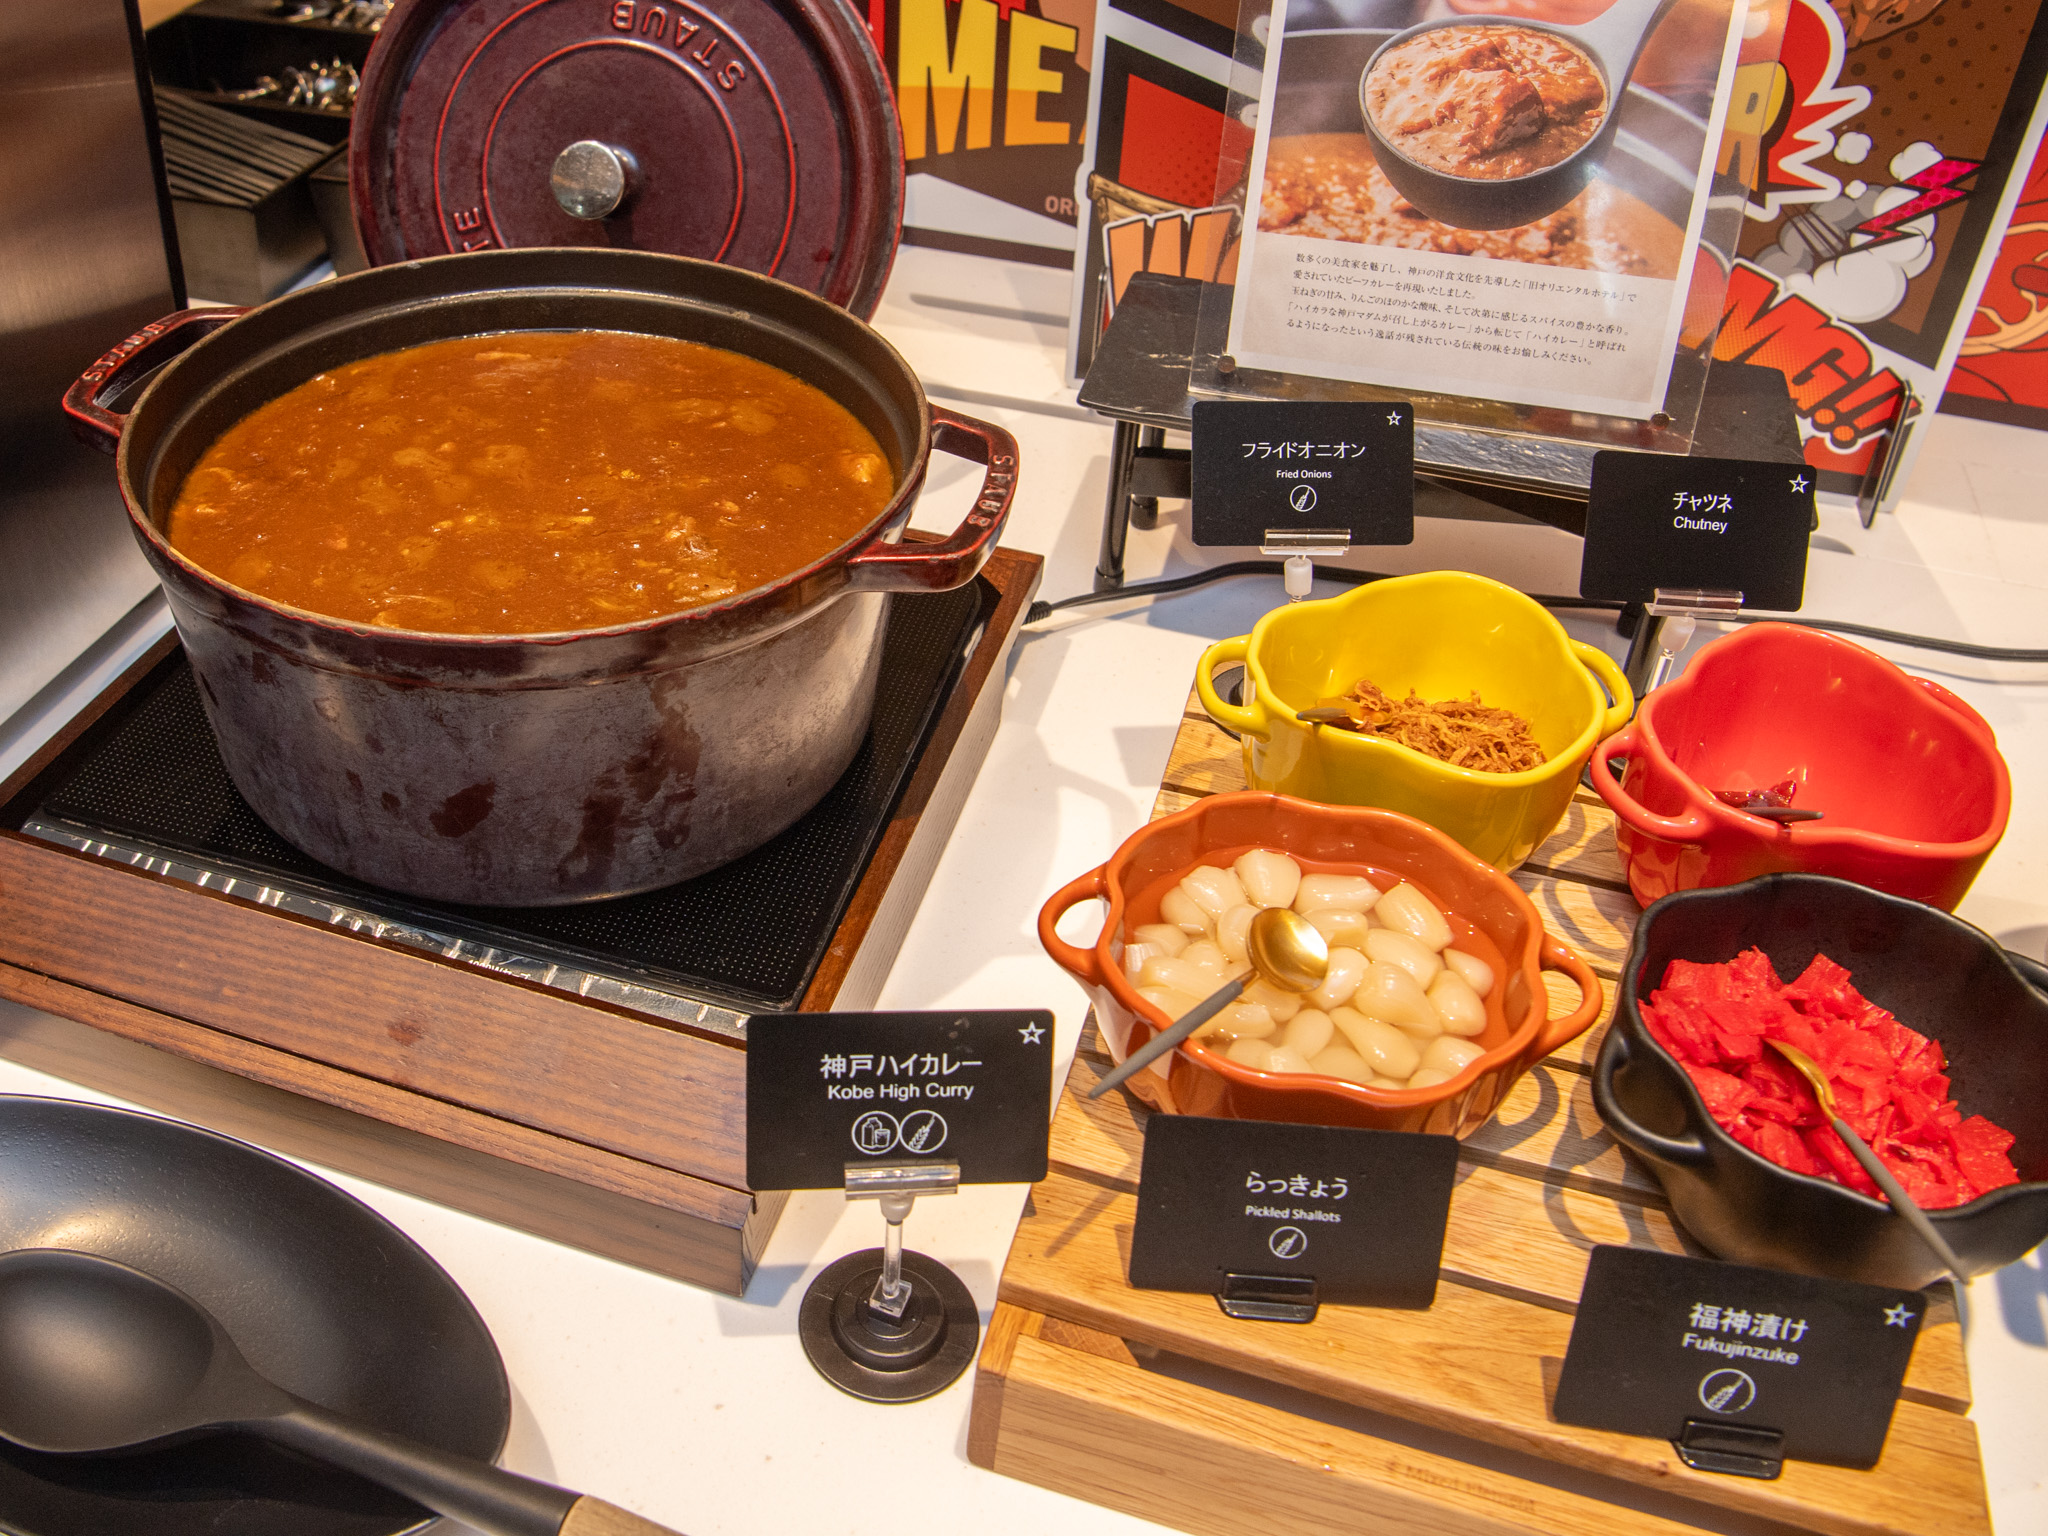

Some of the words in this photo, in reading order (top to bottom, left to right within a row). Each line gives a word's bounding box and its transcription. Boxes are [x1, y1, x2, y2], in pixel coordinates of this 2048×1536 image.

[613, 1, 746, 91] STAUB
[898, 0, 1086, 161] ME
[82, 323, 165, 381] STAUB
[1241, 441, 1366, 459] フライドオニオン
[1276, 469, 1299, 479] Fried
[1300, 469, 1333, 479] Onions
[966, 454, 1015, 527] STAUB
[1672, 491, 1733, 513] チャツネ
[1673, 516, 1728, 534] Chutney
[820, 1053, 983, 1079] 神戸ハイカレー
[827, 1084, 875, 1100] Kobe
[880, 1084, 920, 1102] High
[925, 1083, 975, 1100] Curry
[1245, 1171, 1349, 1200] らっきょう
[1245, 1205, 1290, 1220] Pickled
[1292, 1208, 1342, 1223] Shallots
[1688, 1302, 1809, 1343] 福神漬け
[1681, 1333, 1801, 1366] Fukujinzuke
